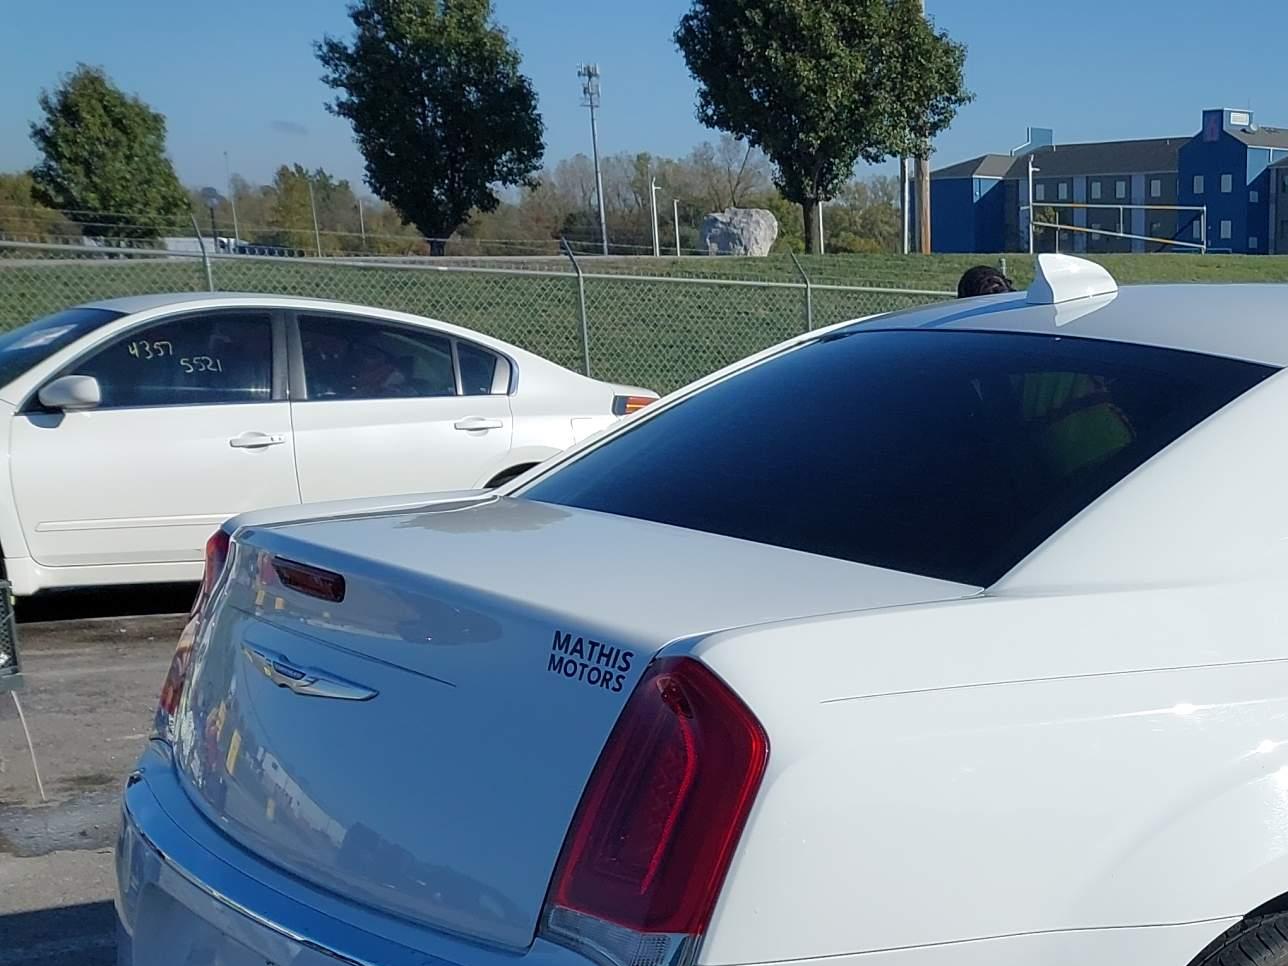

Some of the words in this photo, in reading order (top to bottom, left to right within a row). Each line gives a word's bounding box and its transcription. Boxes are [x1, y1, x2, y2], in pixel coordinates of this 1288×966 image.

[128, 340, 173, 360] 4357
[180, 356, 223, 373] 5521
[552, 630, 635, 672] MATHIS
[547, 653, 626, 692] MOTORS
